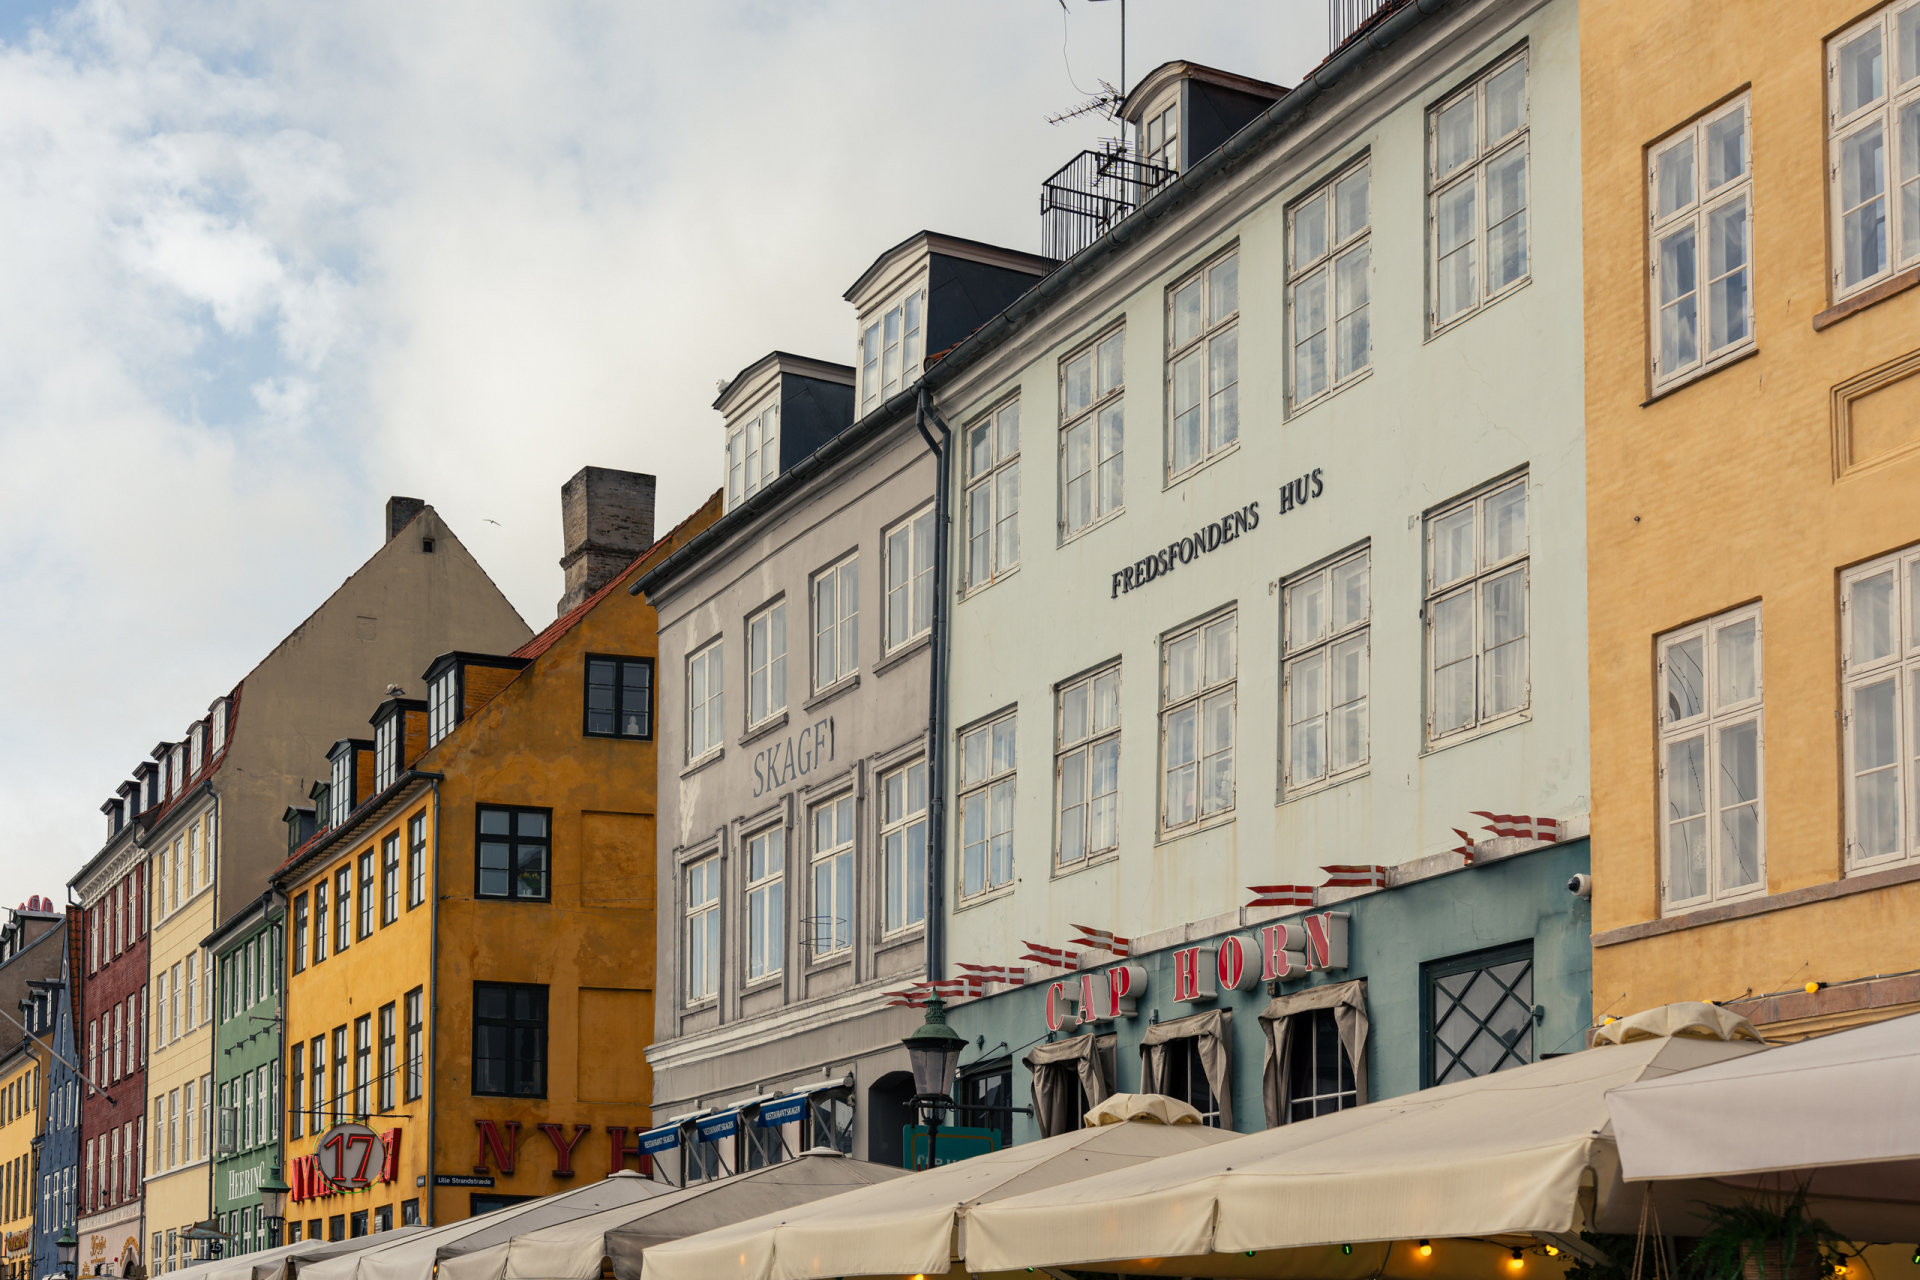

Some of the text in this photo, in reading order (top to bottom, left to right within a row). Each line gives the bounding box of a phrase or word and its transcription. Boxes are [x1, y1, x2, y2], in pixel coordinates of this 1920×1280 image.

[1111, 467, 1324, 599] FREDSFONDENS HUS
[1046, 911, 1334, 1031] CAP HORN
[228, 1161, 265, 1200] HEERING
[324, 1133, 375, 1181] 17
[211, 1243, 221, 1251] 15
